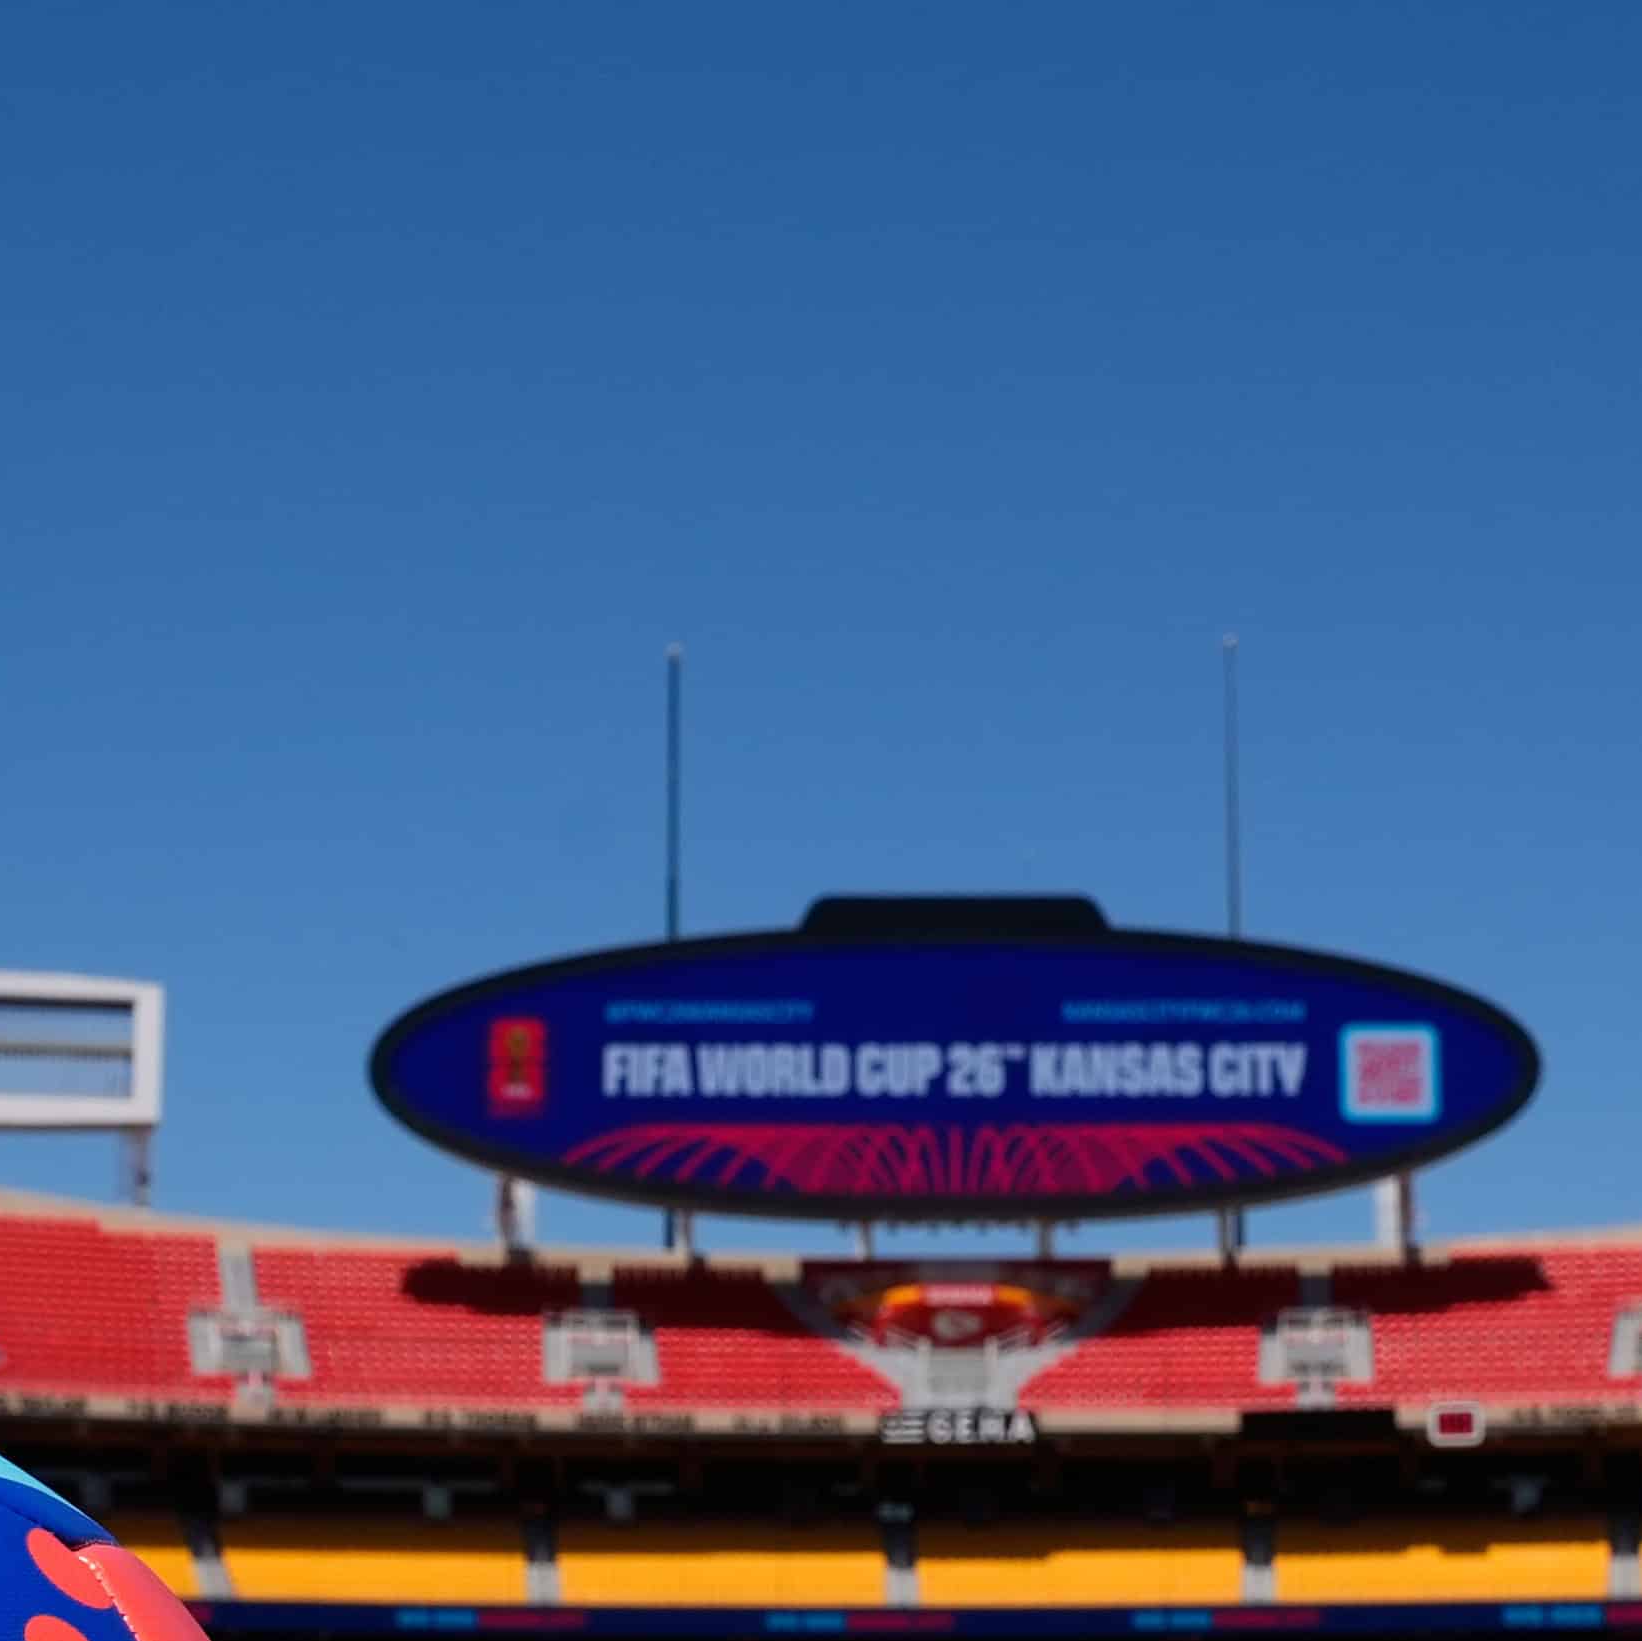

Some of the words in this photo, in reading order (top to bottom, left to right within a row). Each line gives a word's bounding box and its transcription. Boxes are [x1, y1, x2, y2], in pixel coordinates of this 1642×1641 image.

[603, 1043, 693, 1097] FIFA
[695, 1043, 850, 1098] WORLD
[856, 1042, 942, 1097] CUP
[1031, 1043, 1204, 1097] KANSAS
[1209, 1043, 1307, 1097] CITY
